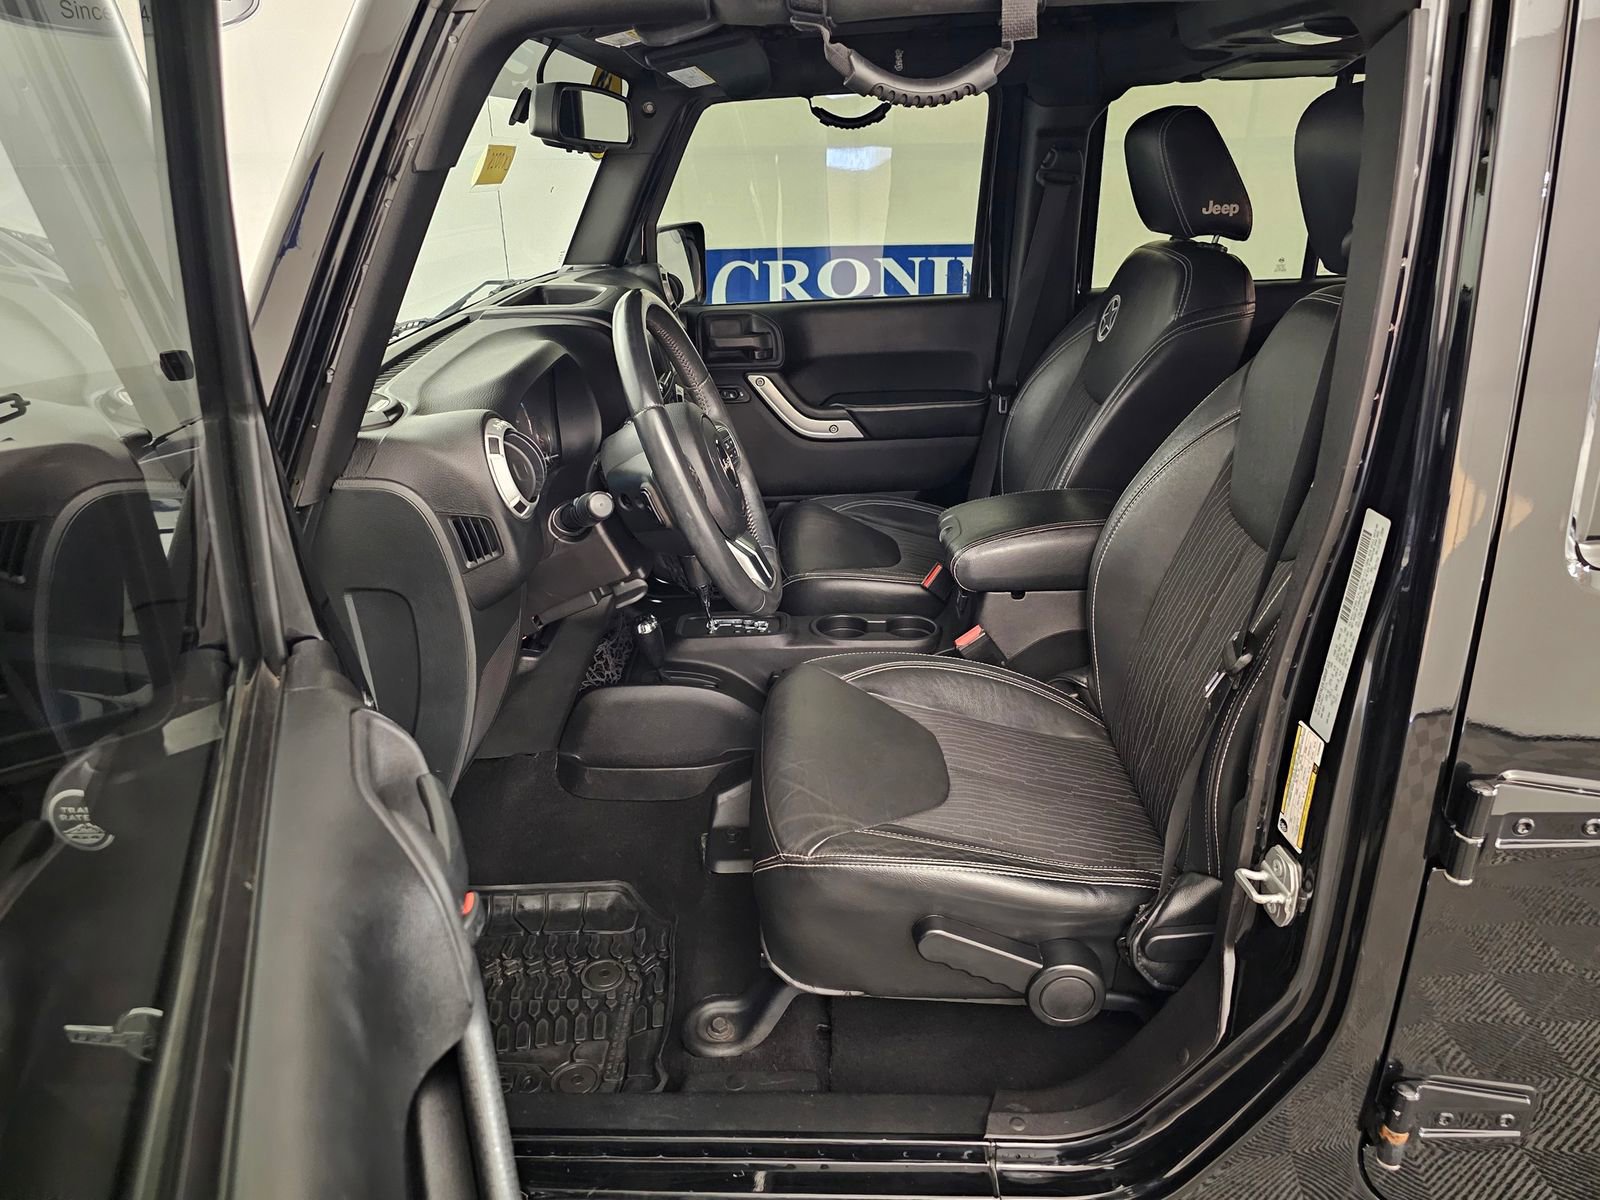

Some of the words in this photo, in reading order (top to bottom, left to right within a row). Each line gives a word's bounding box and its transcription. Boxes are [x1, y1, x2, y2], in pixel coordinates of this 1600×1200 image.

[60, 1, 114, 21] Since
[1202, 200, 1239, 216] Jeep
[711, 257, 972, 304] CRONI
[60, 806, 88, 814] TRAI
